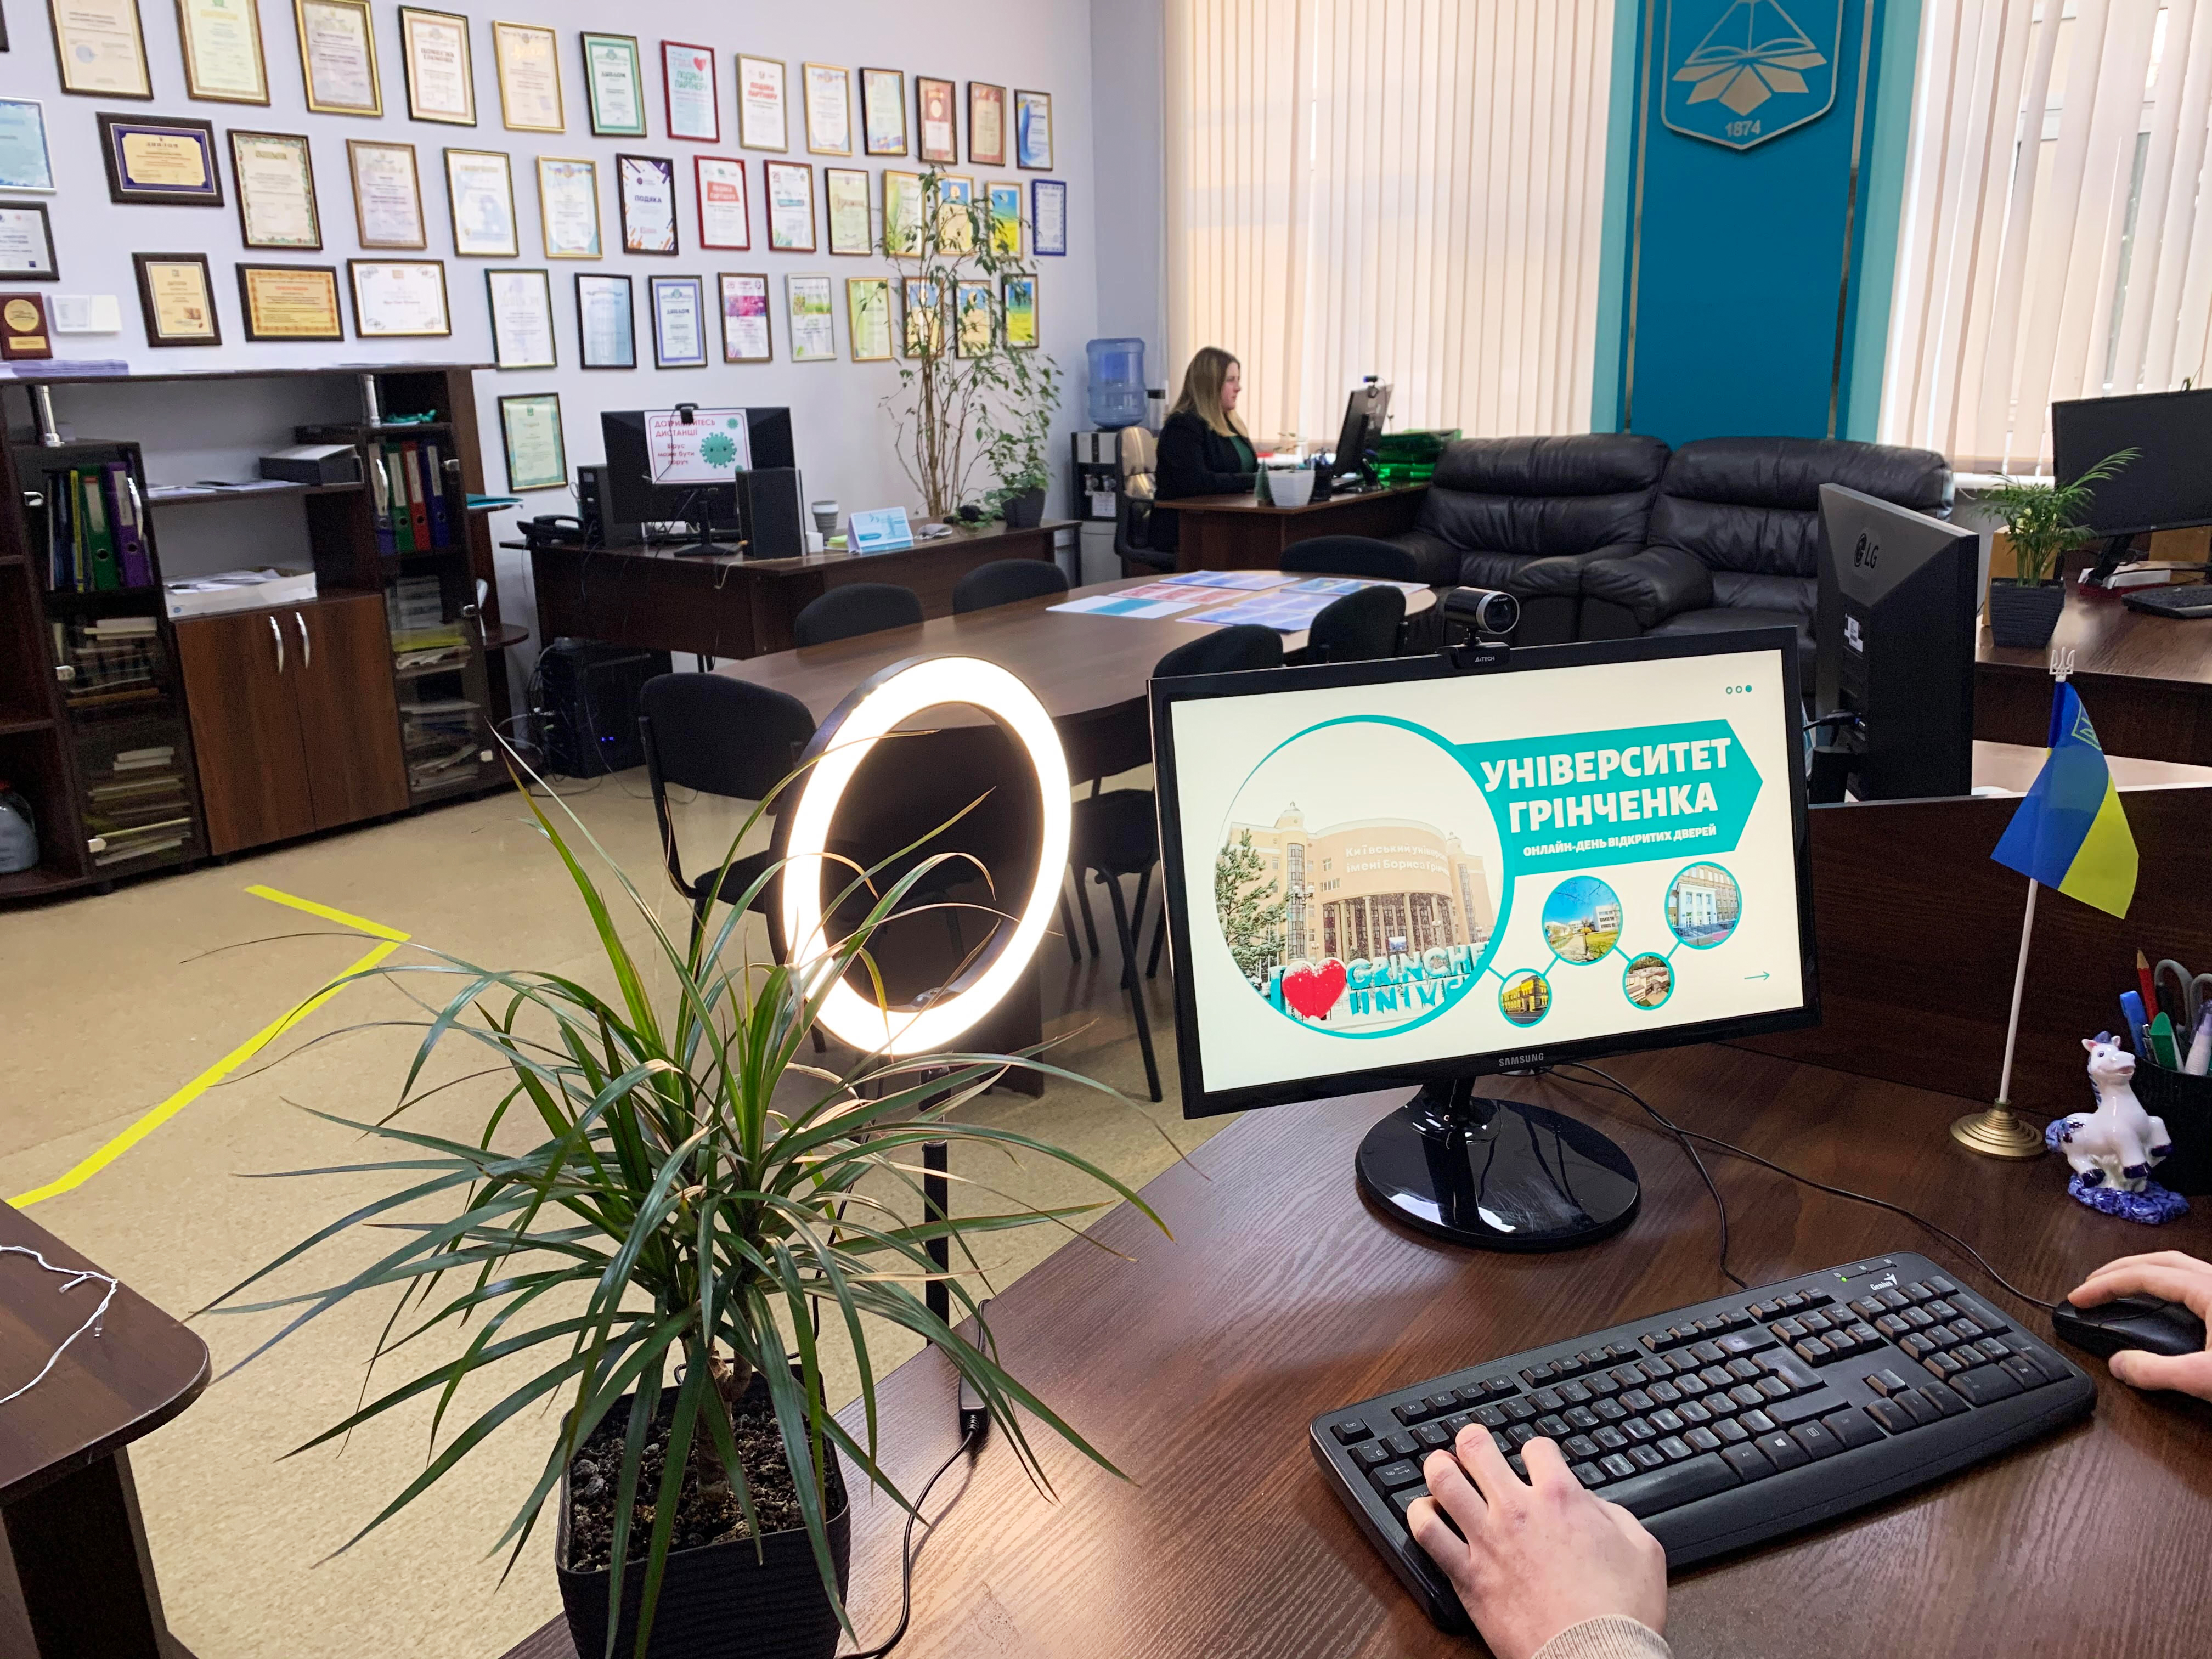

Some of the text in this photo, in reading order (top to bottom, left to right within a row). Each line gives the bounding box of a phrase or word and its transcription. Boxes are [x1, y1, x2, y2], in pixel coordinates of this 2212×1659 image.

[1725, 120, 1761, 137] 1874
[634, 195, 662, 203] ПОДЯКА
[654, 419, 715, 428] ДОТРИЙТЕСЬ
[1864, 542, 1879, 569] LG
[1480, 737, 1731, 792] УНІВЕРСИТЕТ
[1509, 782, 1718, 833] ГРІНЧЕНКА
[1523, 823, 1717, 857] ОНЛАЙН-ДЕНЬ ВІДКРИТИХ ДВЕРЕЙ
[1347, 859, 1381, 873] імені
[1383, 860, 1425, 871] Бориса
[1498, 1053, 1544, 1066] SAMSUNG
[1870, 1281, 1893, 1291] Genius
